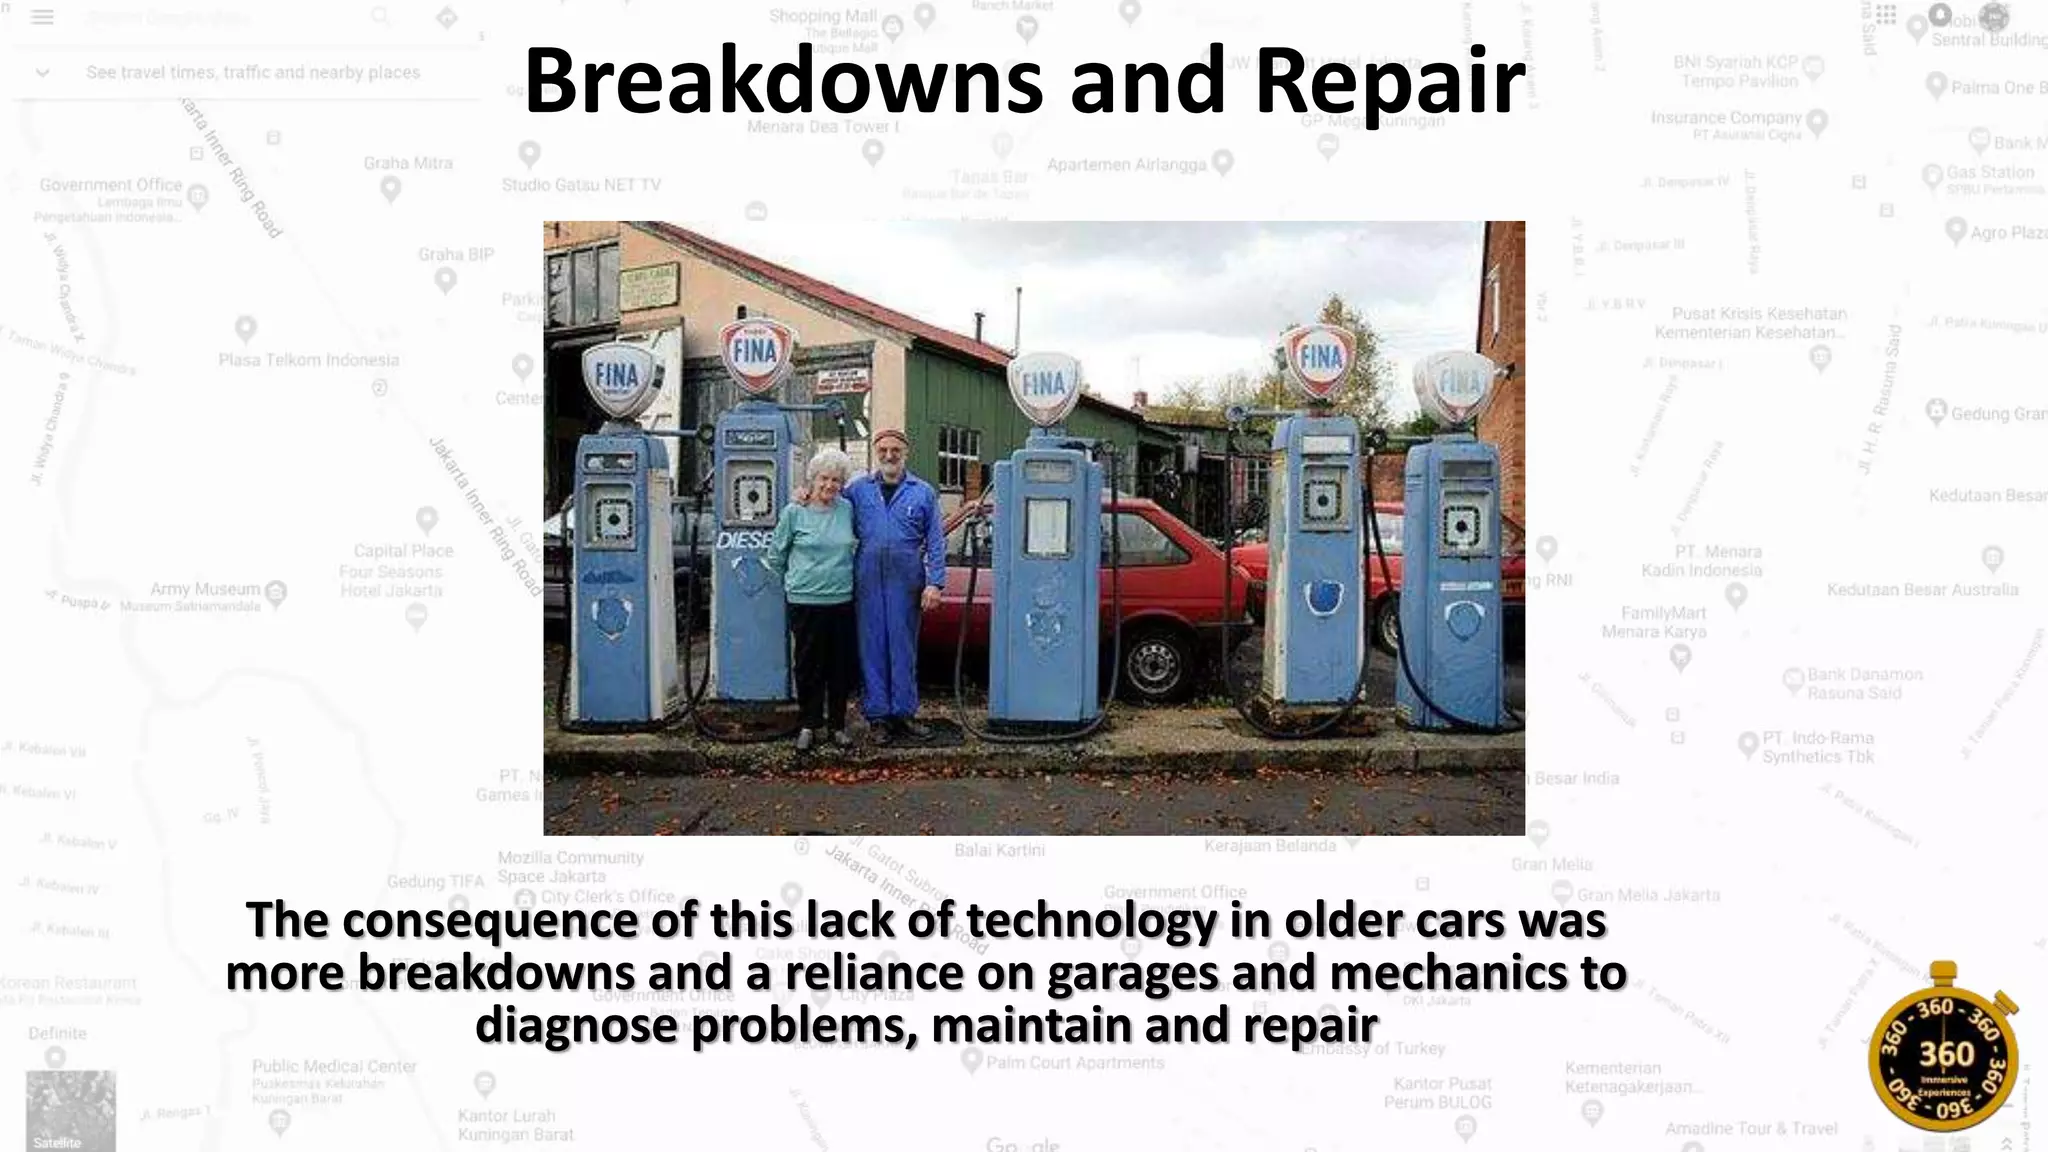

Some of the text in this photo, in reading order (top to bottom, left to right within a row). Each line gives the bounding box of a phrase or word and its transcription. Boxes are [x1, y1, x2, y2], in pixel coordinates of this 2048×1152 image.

[770, 8, 877, 28] Shopping Mall
[853, 42, 879, 54] Mall
[1932, 32, 2048, 48] Sentral Building
[1226, 56, 1250, 69] JW
[1674, 54, 1798, 71] BNI Syariah KCP
[86, 64, 421, 84] See travel times, traffic and nearby places
[1682, 72, 1799, 90] Tempo Pavilion
[1952, 80, 2034, 95] Palma One
[747, 120, 804, 134] Menara
[810, 120, 838, 133] Dea
[844, 119, 889, 133] Tower
[1652, 111, 1802, 129] Insurance Company
[1995, 136, 2033, 150] Bank
[364, 156, 453, 170] Graha Mitra
[1048, 158, 1207, 175] Apartemen Airlangga
[1947, 164, 2035, 180] Gas Station
[40, 176, 183, 192] Government Office
[502, 178, 551, 192] Studio
[605, 176, 636, 192] NET
[638, 178, 661, 191] TV
[419, 247, 495, 264] Graha BIP
[1673, 307, 1847, 321] Pusat Krisis Kesehatan
[734, 338, 776, 363] FINA
[1301, 343, 1342, 370] FINA
[219, 352, 399, 368] Plasa Telkom Indonesia
[596, 362, 638, 387] FINA
[1023, 367, 1067, 396] FINA
[1439, 368, 1482, 396] FINA
[1952, 406, 2010, 424] Gedung
[716, 531, 774, 549] DIESE
[354, 543, 454, 561] Capital Place
[339, 564, 443, 579] Four Seasons
[1642, 563, 1763, 578] Kadin Indonesia
[1546, 574, 1573, 588] RNI
[1828, 582, 2019, 596] Kedutaan Besar Australia
[151, 582, 261, 599] Army Museum
[341, 583, 443, 598] Hotel Jakarta
[1622, 606, 1706, 622] FamilyMart
[1602, 624, 1660, 638] Menara
[1808, 667, 1924, 681] Bank Danamon
[1808, 685, 1902, 701] Rasuna Said
[1535, 771, 1620, 786] Besar India
[476, 788, 530, 803] Games
[955, 842, 1044, 857] Balai Kartini
[1205, 836, 1336, 856] Kerajaan Belanda
[498, 850, 644, 870] Mozilla Community
[387, 874, 485, 892] Gedung TIFA
[498, 869, 607, 887] Space Jakarta
[542, 890, 569, 906] City
[629, 889, 676, 904] Office
[1104, 884, 1247, 902] Government Office
[55, 975, 136, 990] Restaurant
[29, 1026, 87, 1040] Definite
[253, 1058, 417, 1078] Public Medical Center
[987, 1055, 1165, 1072] Palm Court Apartments
[1566, 1060, 1661, 1076] Kementerian
[1394, 1076, 1492, 1092] Kantor Pusat
[1385, 1095, 1492, 1109] Perum BULOG
[458, 1108, 555, 1124] Kantor Lurah
[459, 1127, 575, 1144] Kuningan Barat
[1665, 1122, 1733, 1136] Amadine
[1738, 1121, 1772, 1136] Tour
[1792, 1121, 1838, 1135] Travel
